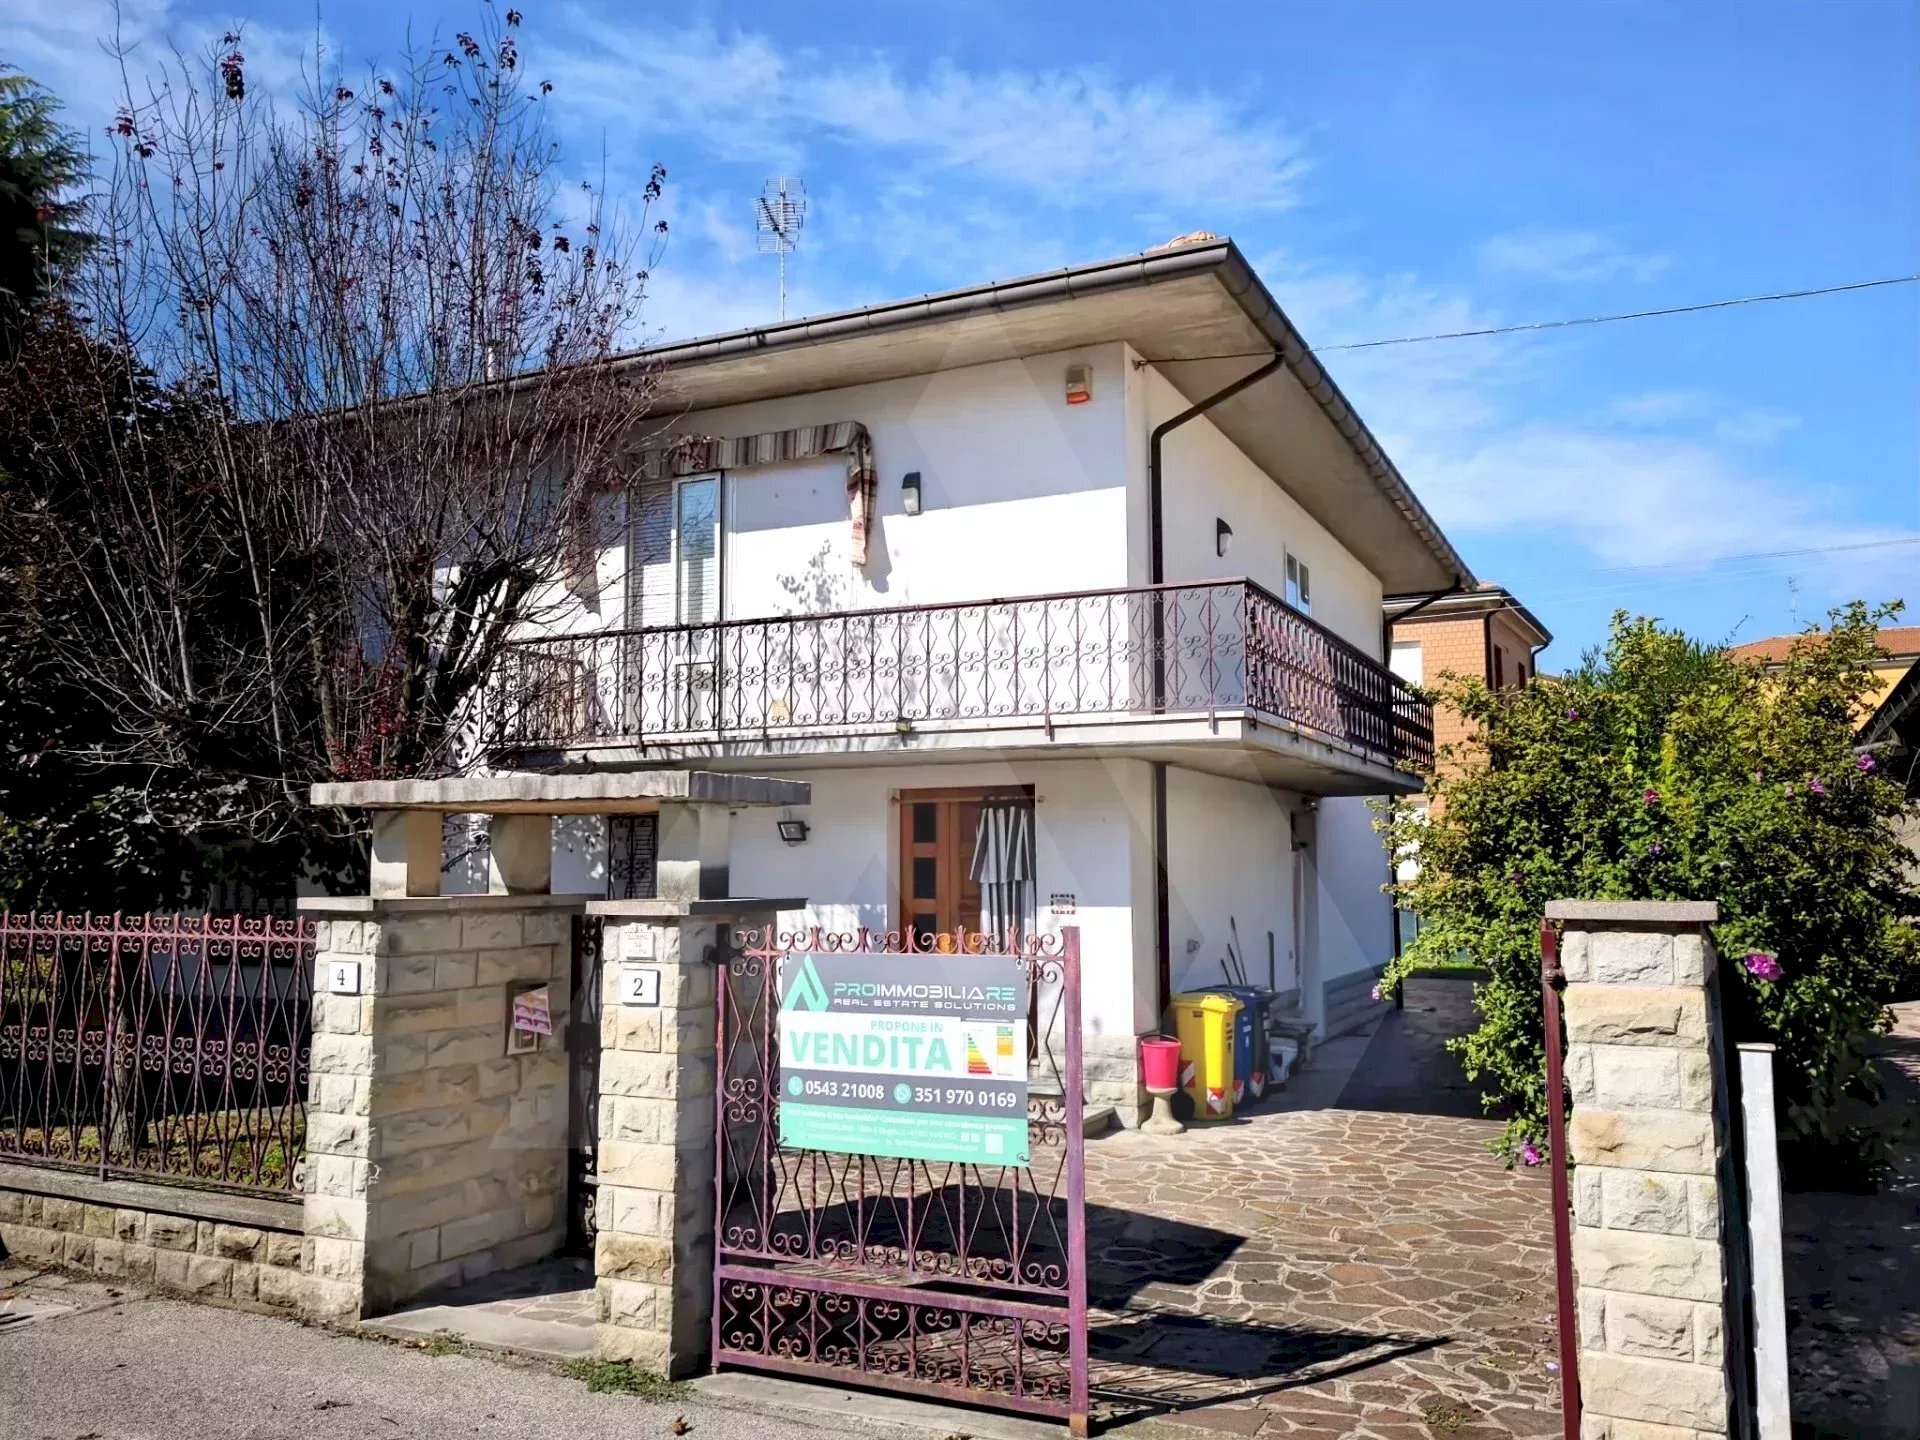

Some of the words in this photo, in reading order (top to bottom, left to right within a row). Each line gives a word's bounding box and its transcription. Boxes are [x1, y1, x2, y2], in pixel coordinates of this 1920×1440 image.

[336, 968, 346, 985] 4
[633, 977, 643, 996] 2
[833, 982, 1016, 1001] PROIMMOBILIARE
[833, 998, 869, 1007] REAL
[873, 999, 929, 1009] ESTATE
[934, 1001, 1016, 1012] SOLUTIONS
[870, 1020, 927, 1033] PROPONE
[930, 1022, 944, 1033] IN
[789, 1030, 953, 1071] VENDITA
[805, 1080, 838, 1096] 0543
[841, 1082, 885, 1100] 21008
[915, 1087, 941, 1103] 351
[946, 1089, 974, 1105] 970
[978, 1091, 1017, 1108] 0169
